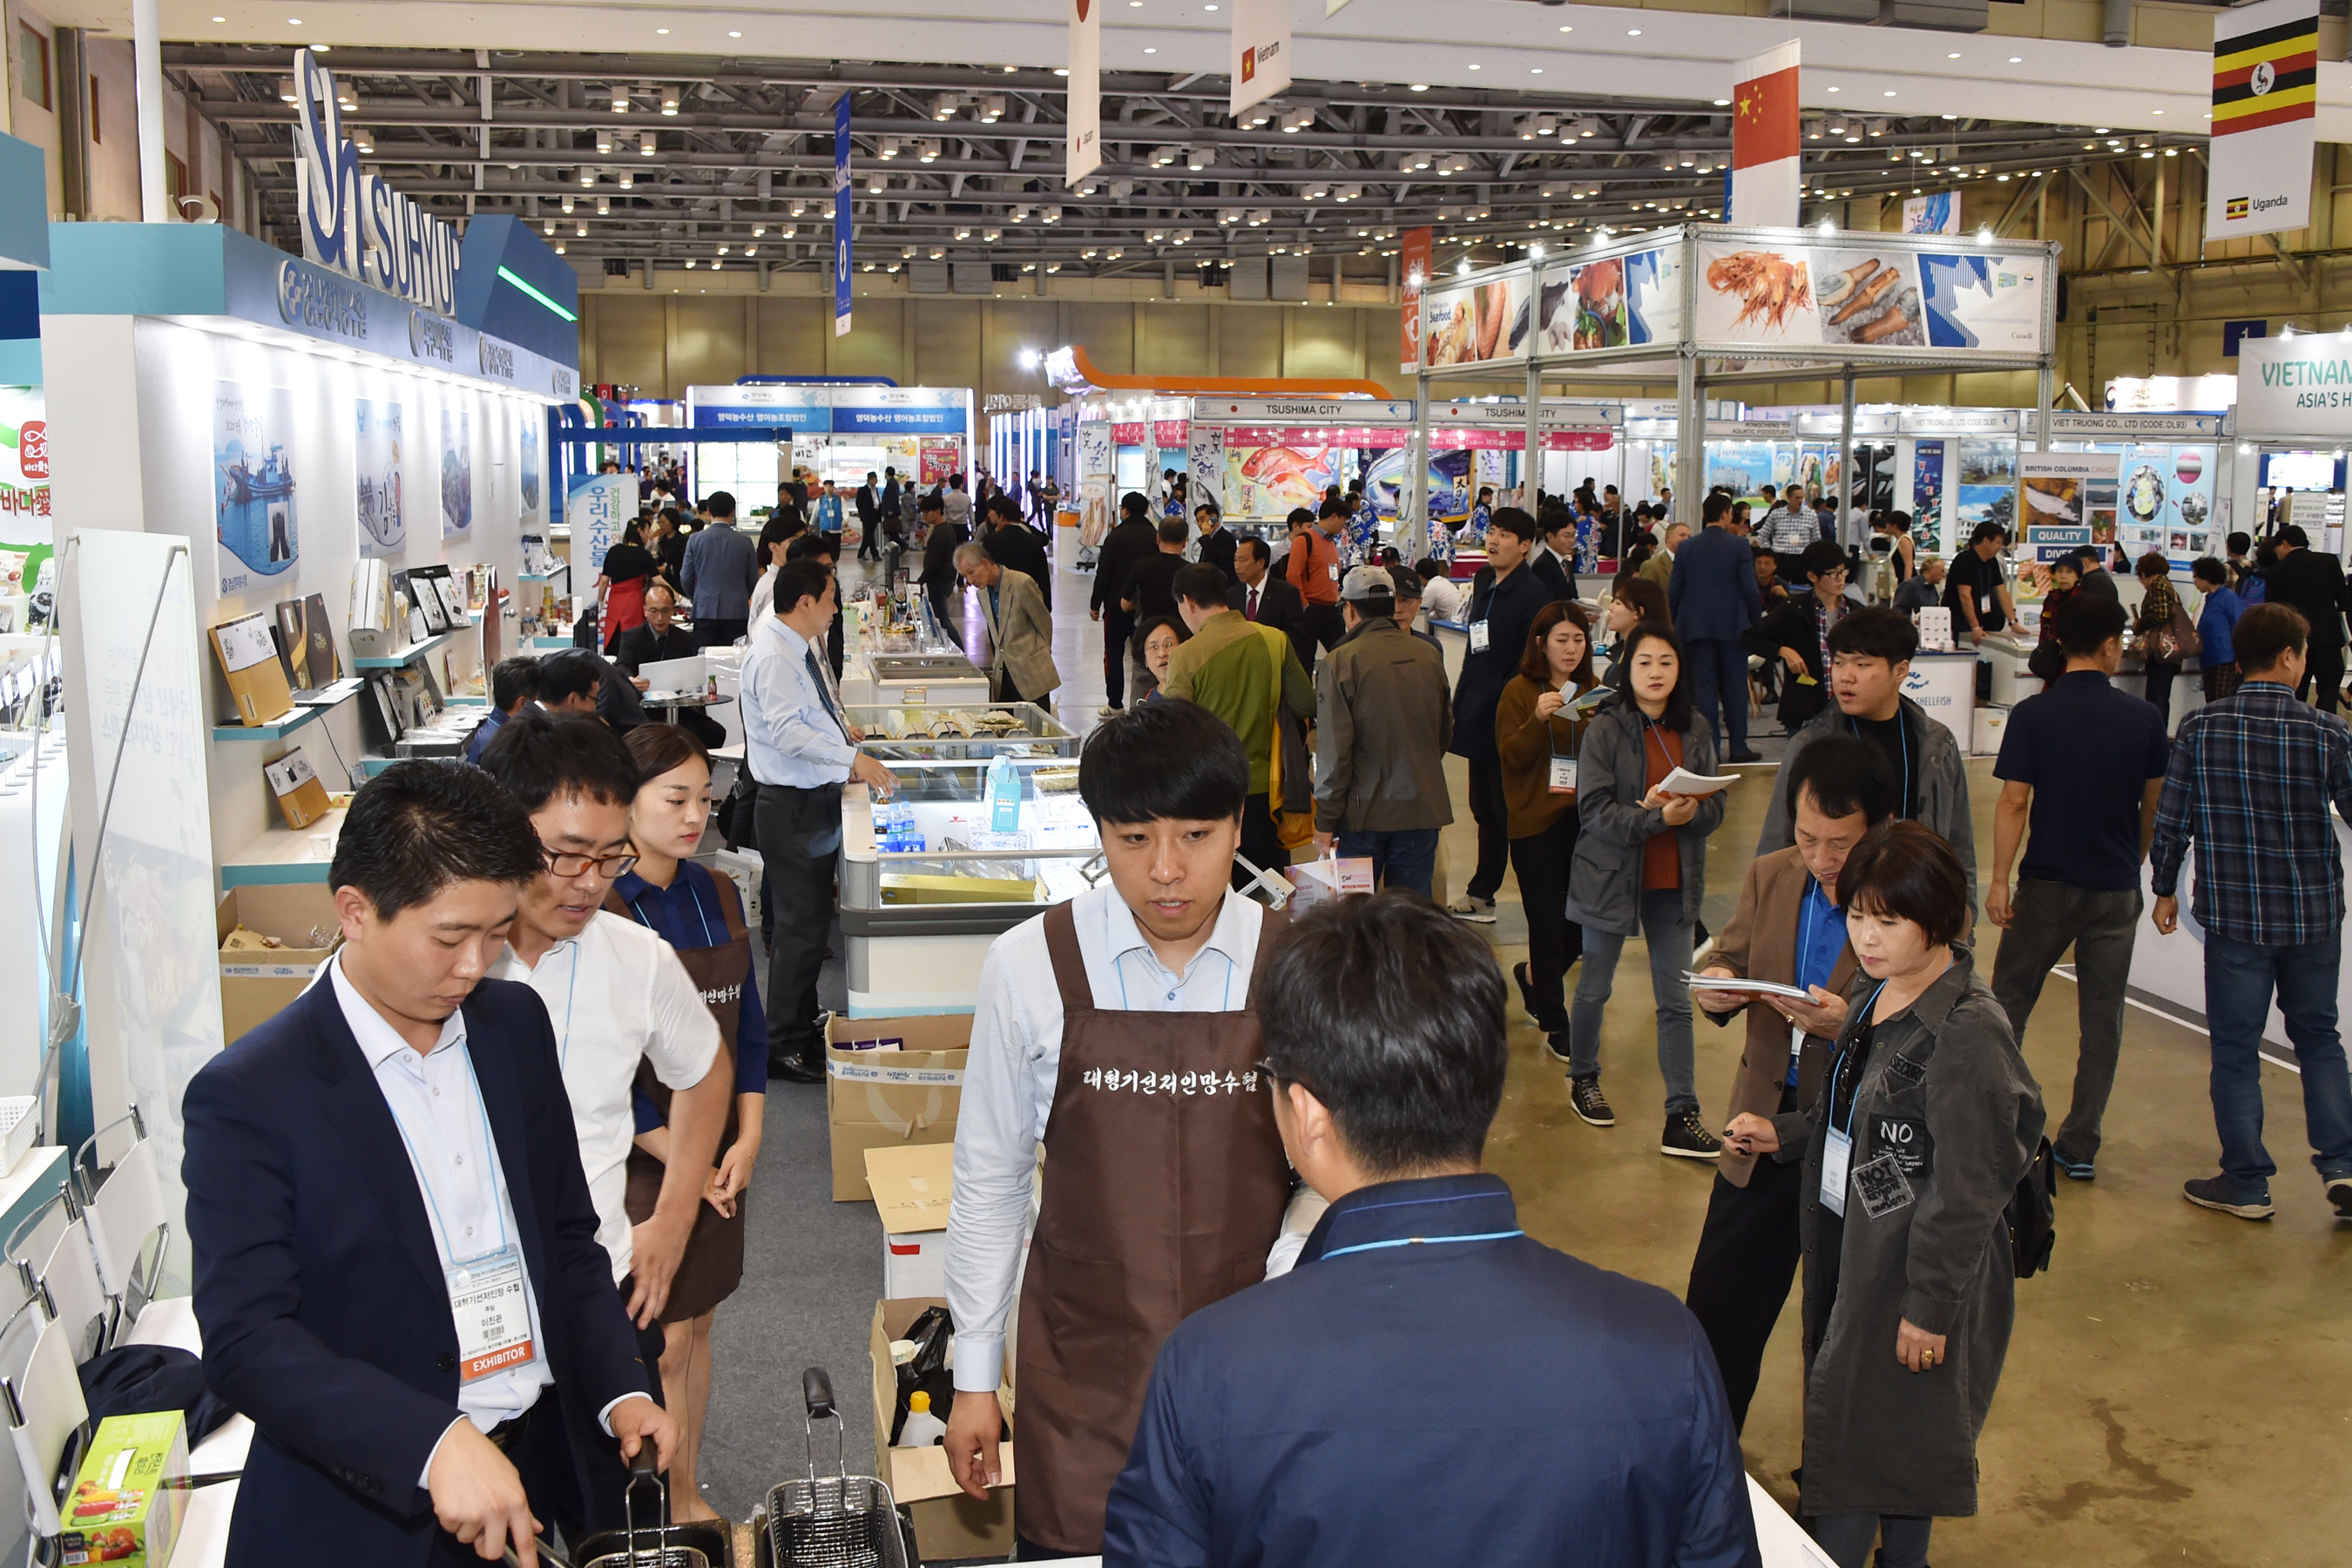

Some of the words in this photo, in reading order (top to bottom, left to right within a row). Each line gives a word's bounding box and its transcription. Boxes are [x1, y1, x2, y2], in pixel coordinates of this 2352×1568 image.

[1256, 41, 1280, 64] Vietnam
[2253, 195, 2288, 212] Uganda
[360, 174, 462, 316] SUHYUP
[1429, 308, 1451, 323] Seafood
[1266, 404, 1316, 415] TSUSHIMA
[1320, 405, 1342, 415] CITY
[1484, 408, 1525, 417] TSUSHIM
[1539, 409, 1557, 418] ITY
[2052, 419, 2070, 428] VIET
[2072, 419, 2104, 428] TRUONG
[2124, 420, 2138, 429] LTD
[610, 487, 621, 531] 건강하고
[587, 486, 610, 567] 우리수산물
[2038, 531, 2081, 541] QUALITY
[1916, 697, 1951, 706] SHELLFISH
[1083, 1066, 1258, 1097] 대형기선저인망수협
[1880, 1120, 1913, 1144] NO
[1857, 1160, 1894, 1186] NOT
[1866, 1181, 1901, 1201] KEYNOTE
[506, 1282, 520, 1294] 수협
[473, 1347, 525, 1372] EXHIBITOR
